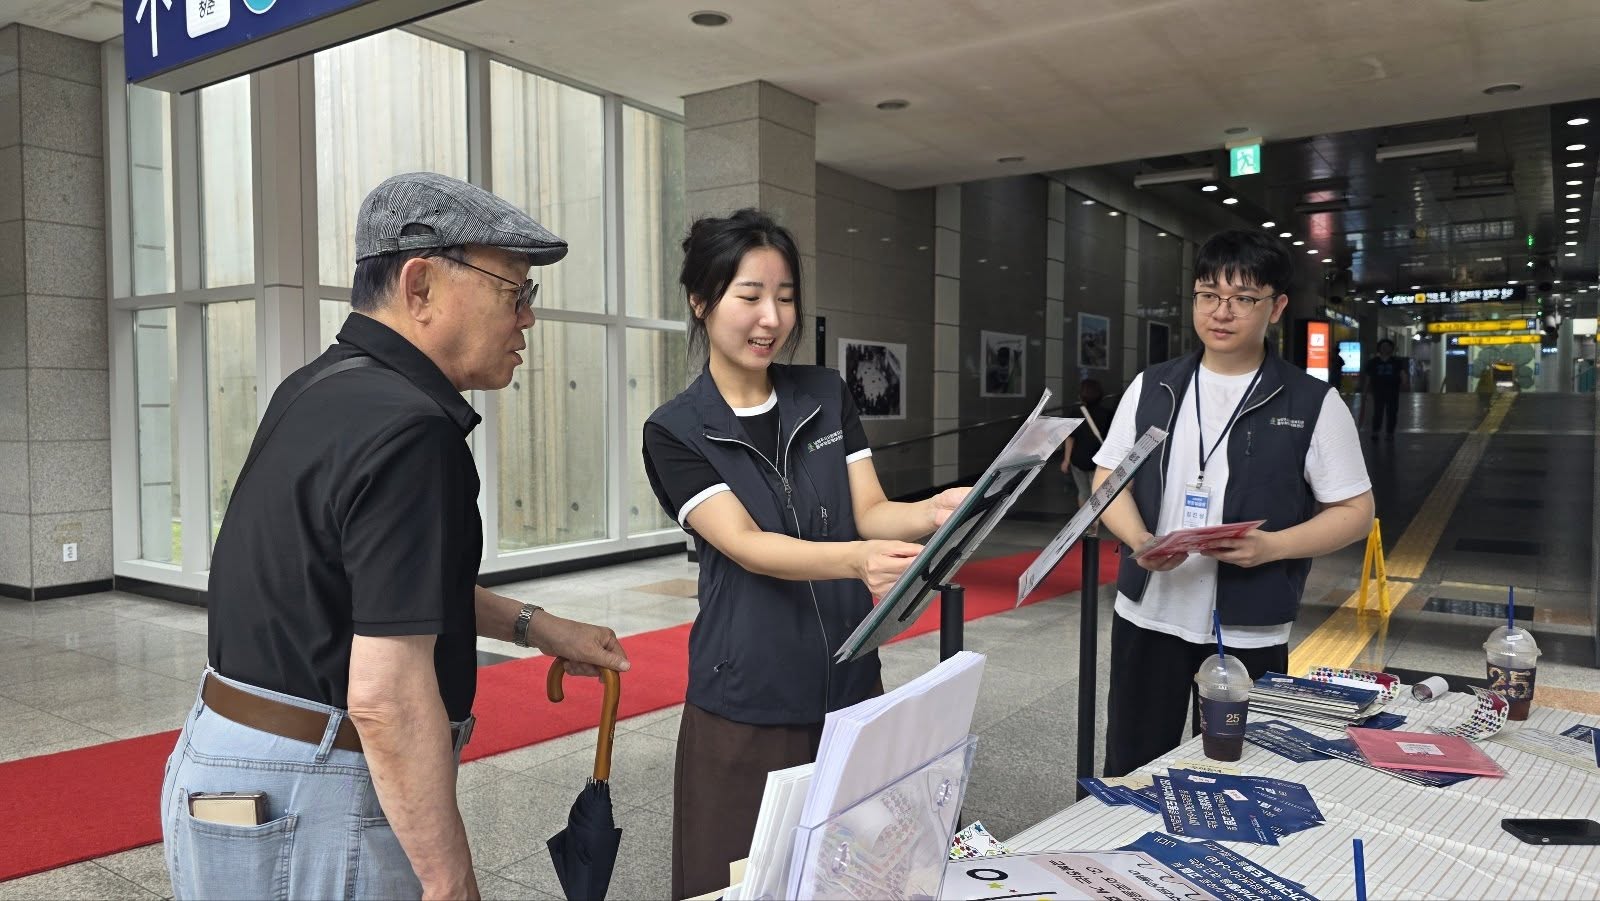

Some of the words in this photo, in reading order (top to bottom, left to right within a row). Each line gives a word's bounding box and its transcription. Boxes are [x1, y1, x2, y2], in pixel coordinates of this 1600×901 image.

[199, 0, 216, 18] 청춘
[1488, 667, 1531, 699] 25
[1226, 713, 1240, 723] 25
